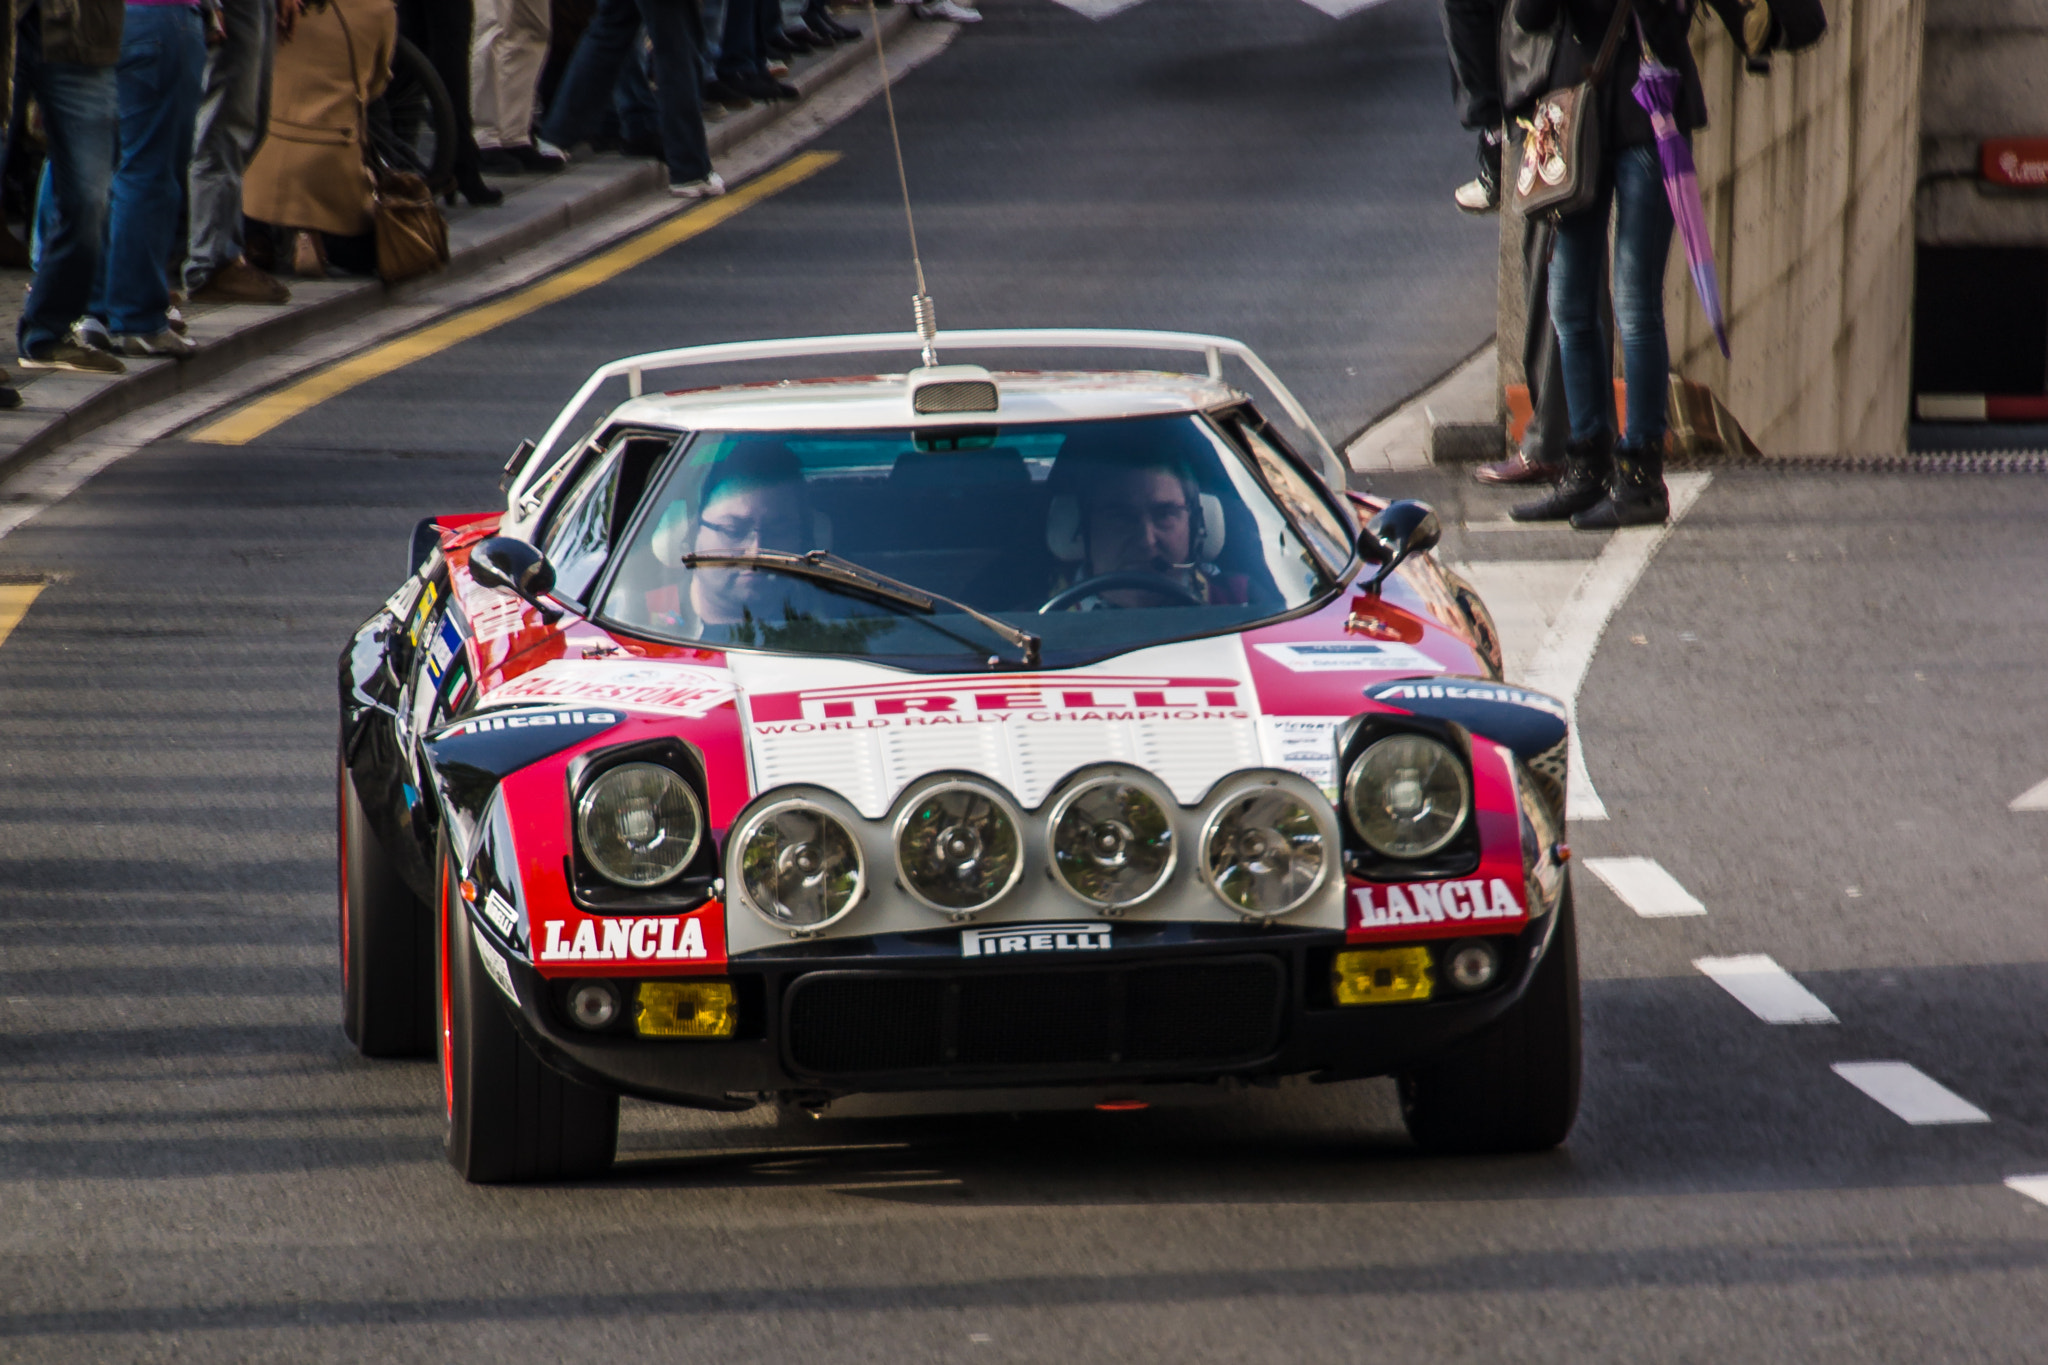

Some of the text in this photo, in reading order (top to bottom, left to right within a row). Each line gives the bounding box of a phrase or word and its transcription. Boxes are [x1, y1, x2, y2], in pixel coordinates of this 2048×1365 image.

[749, 675, 1241, 724] PIRELLI
[434, 711, 616, 740] Alitalia
[756, 710, 1250, 736] WORLD RALLY CHAMPIONS
[1352, 878, 1524, 928] LANCIA
[540, 917, 707, 960] LANCIA
[961, 923, 1112, 958] PIRELLI
